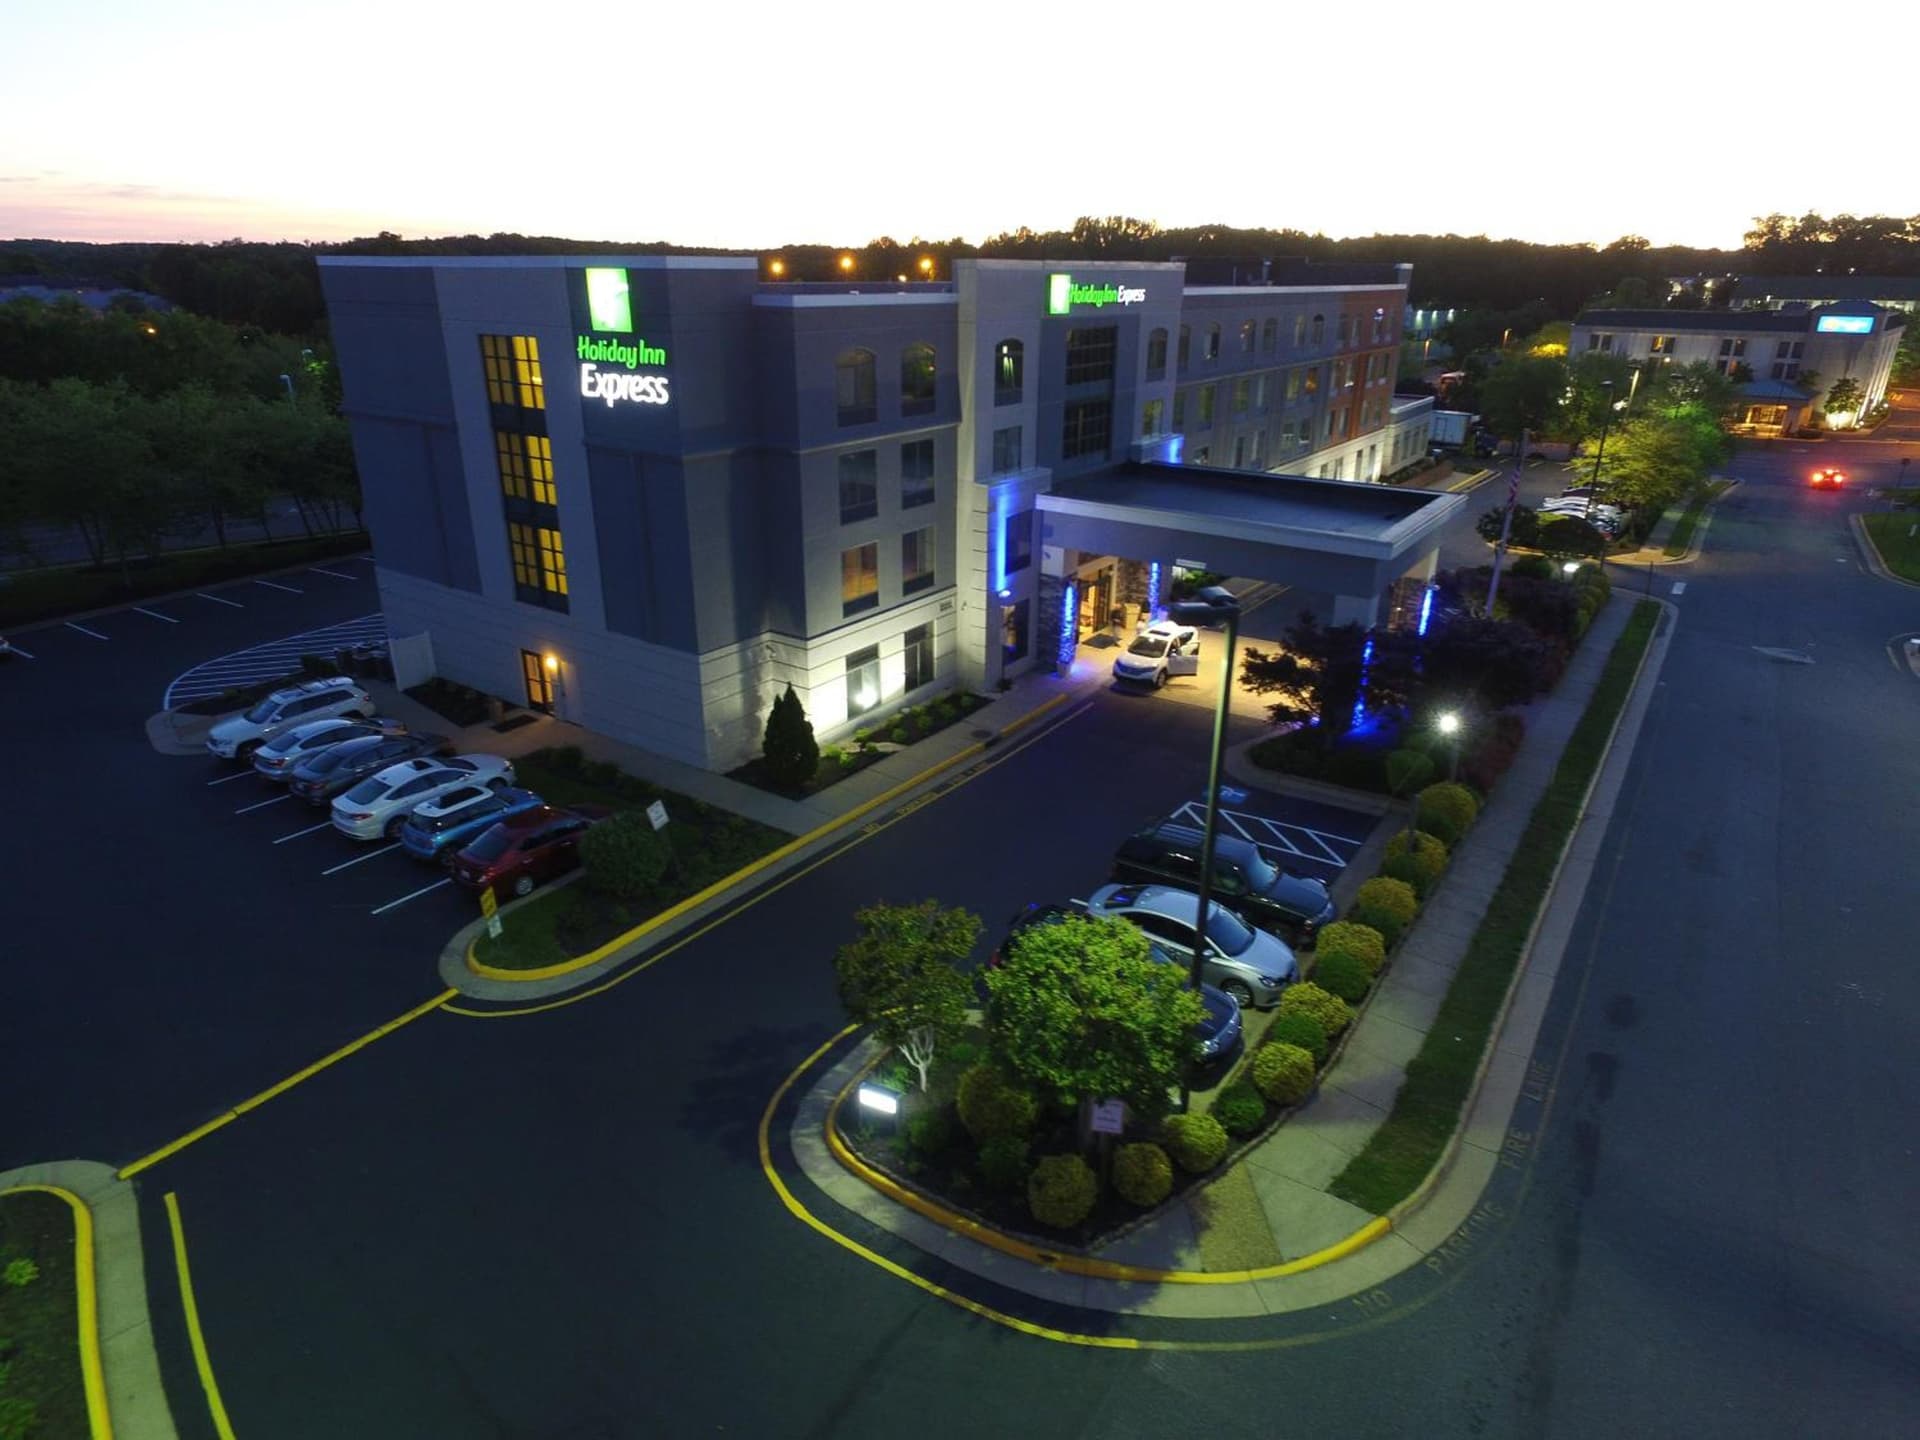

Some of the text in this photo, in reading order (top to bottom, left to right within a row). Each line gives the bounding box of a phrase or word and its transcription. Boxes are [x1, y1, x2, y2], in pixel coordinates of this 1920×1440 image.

[577, 335, 666, 369] Holiday Inn
[581, 363, 669, 408] Express
